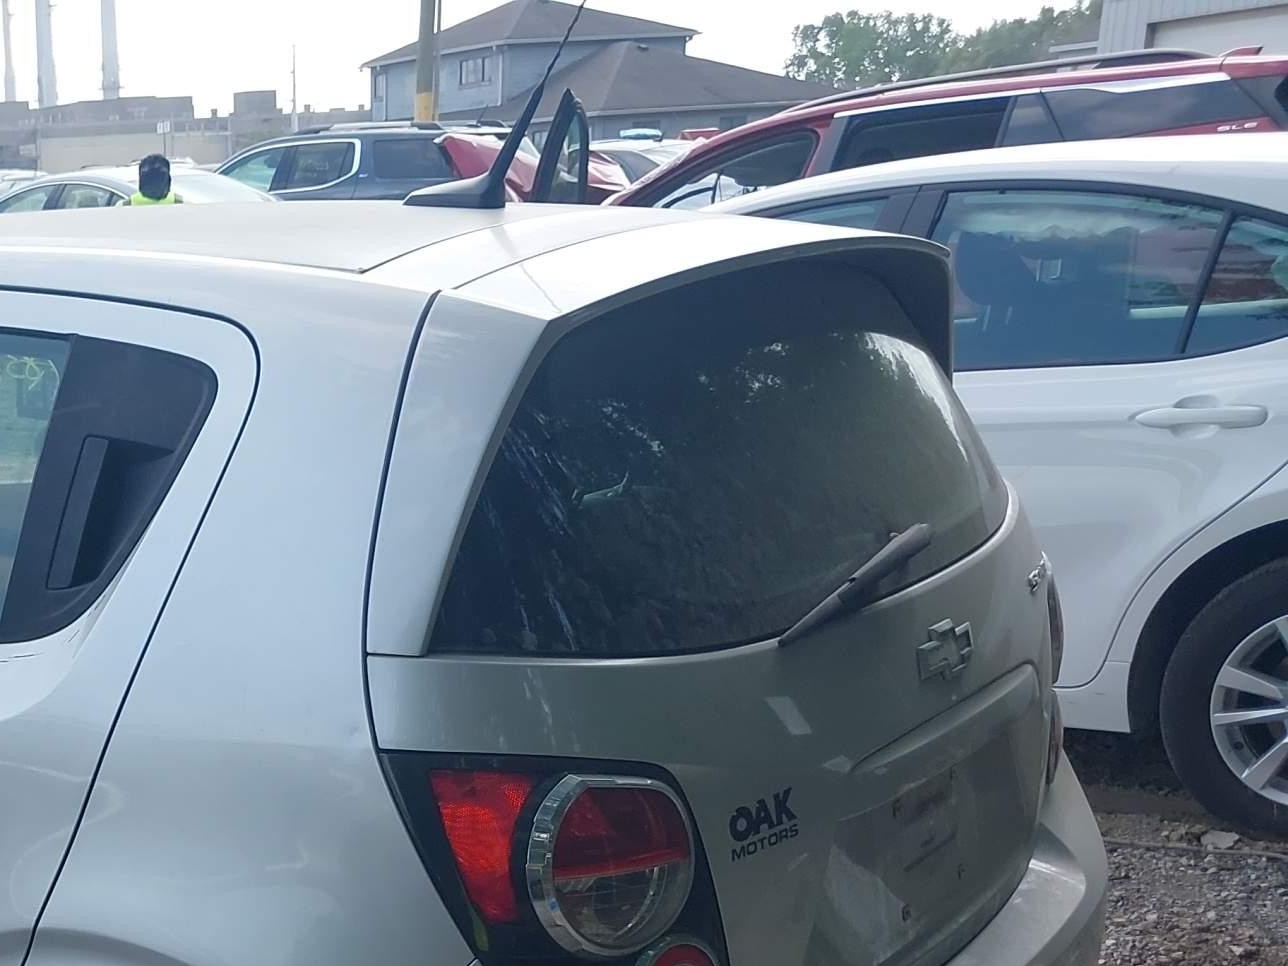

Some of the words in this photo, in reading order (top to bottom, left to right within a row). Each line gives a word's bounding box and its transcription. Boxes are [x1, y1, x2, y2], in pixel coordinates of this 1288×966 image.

[1216, 121, 1258, 132] SLE
[729, 787, 798, 842] OAK
[731, 823, 800, 862] MOTORS
